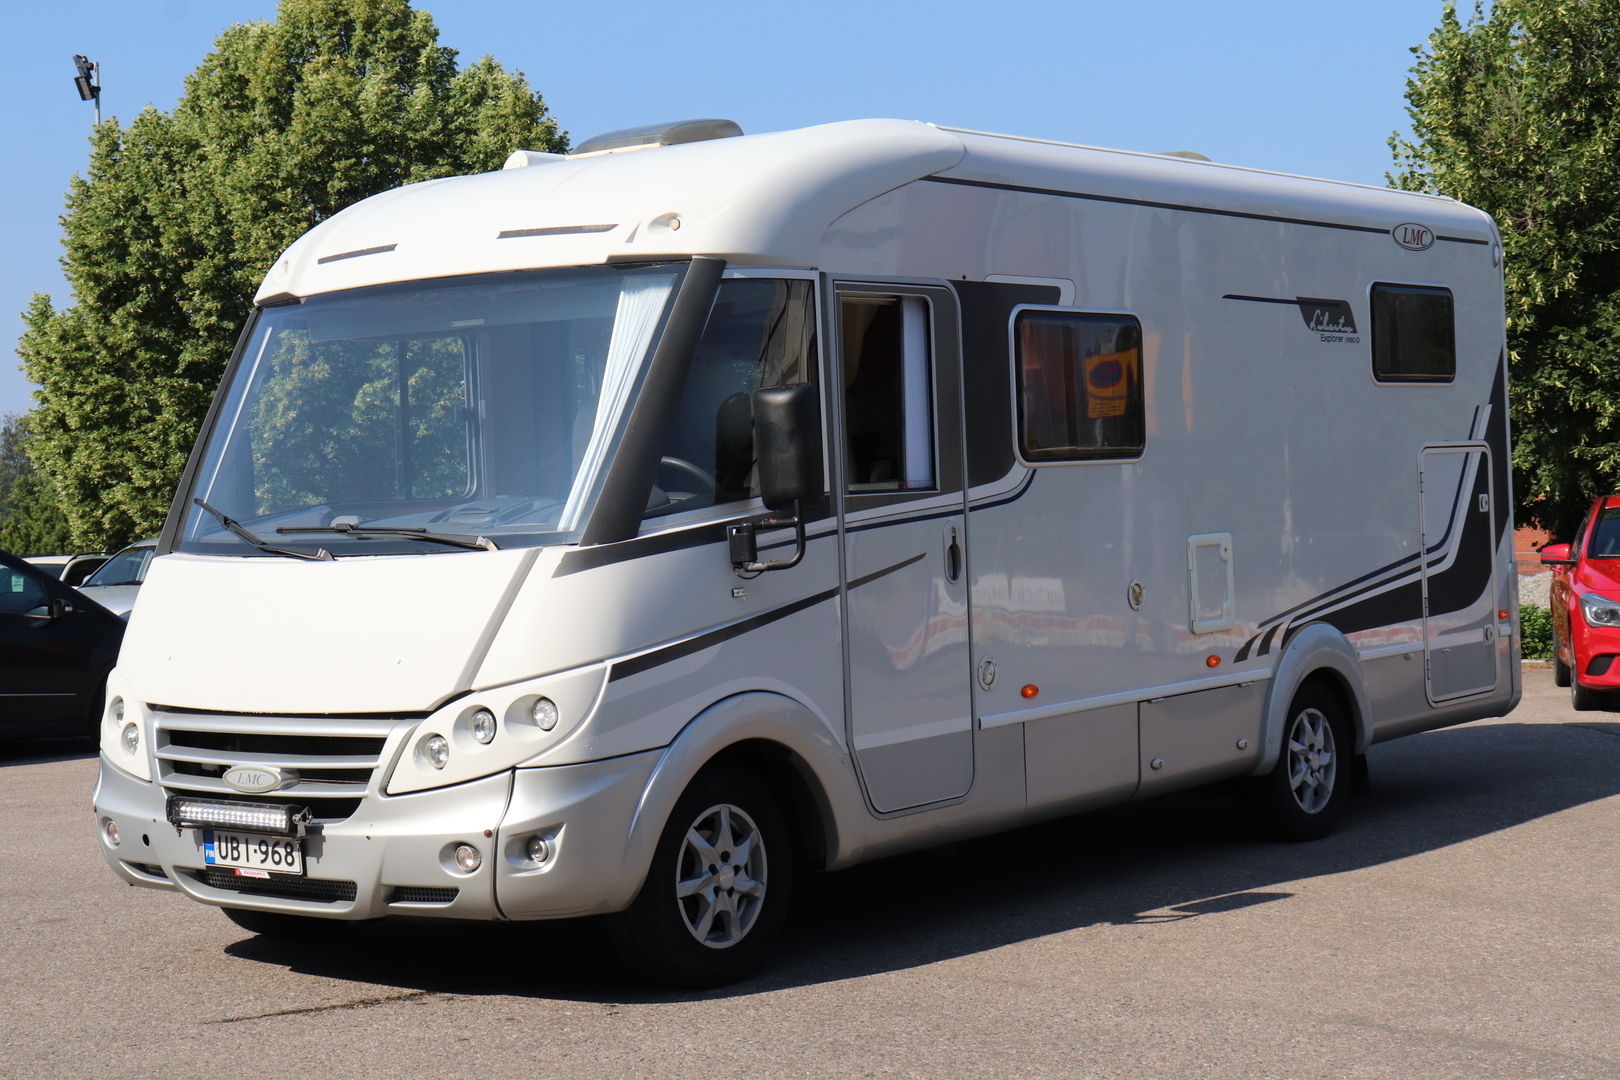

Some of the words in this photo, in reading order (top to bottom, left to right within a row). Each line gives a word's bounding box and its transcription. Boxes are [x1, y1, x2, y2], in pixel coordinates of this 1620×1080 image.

[1402, 226, 1428, 247] LMC
[1320, 333, 1344, 344] Explorer
[236, 772, 266, 787] LMC
[205, 849, 215, 858] FIN
[217, 834, 296, 867] UBI-968
